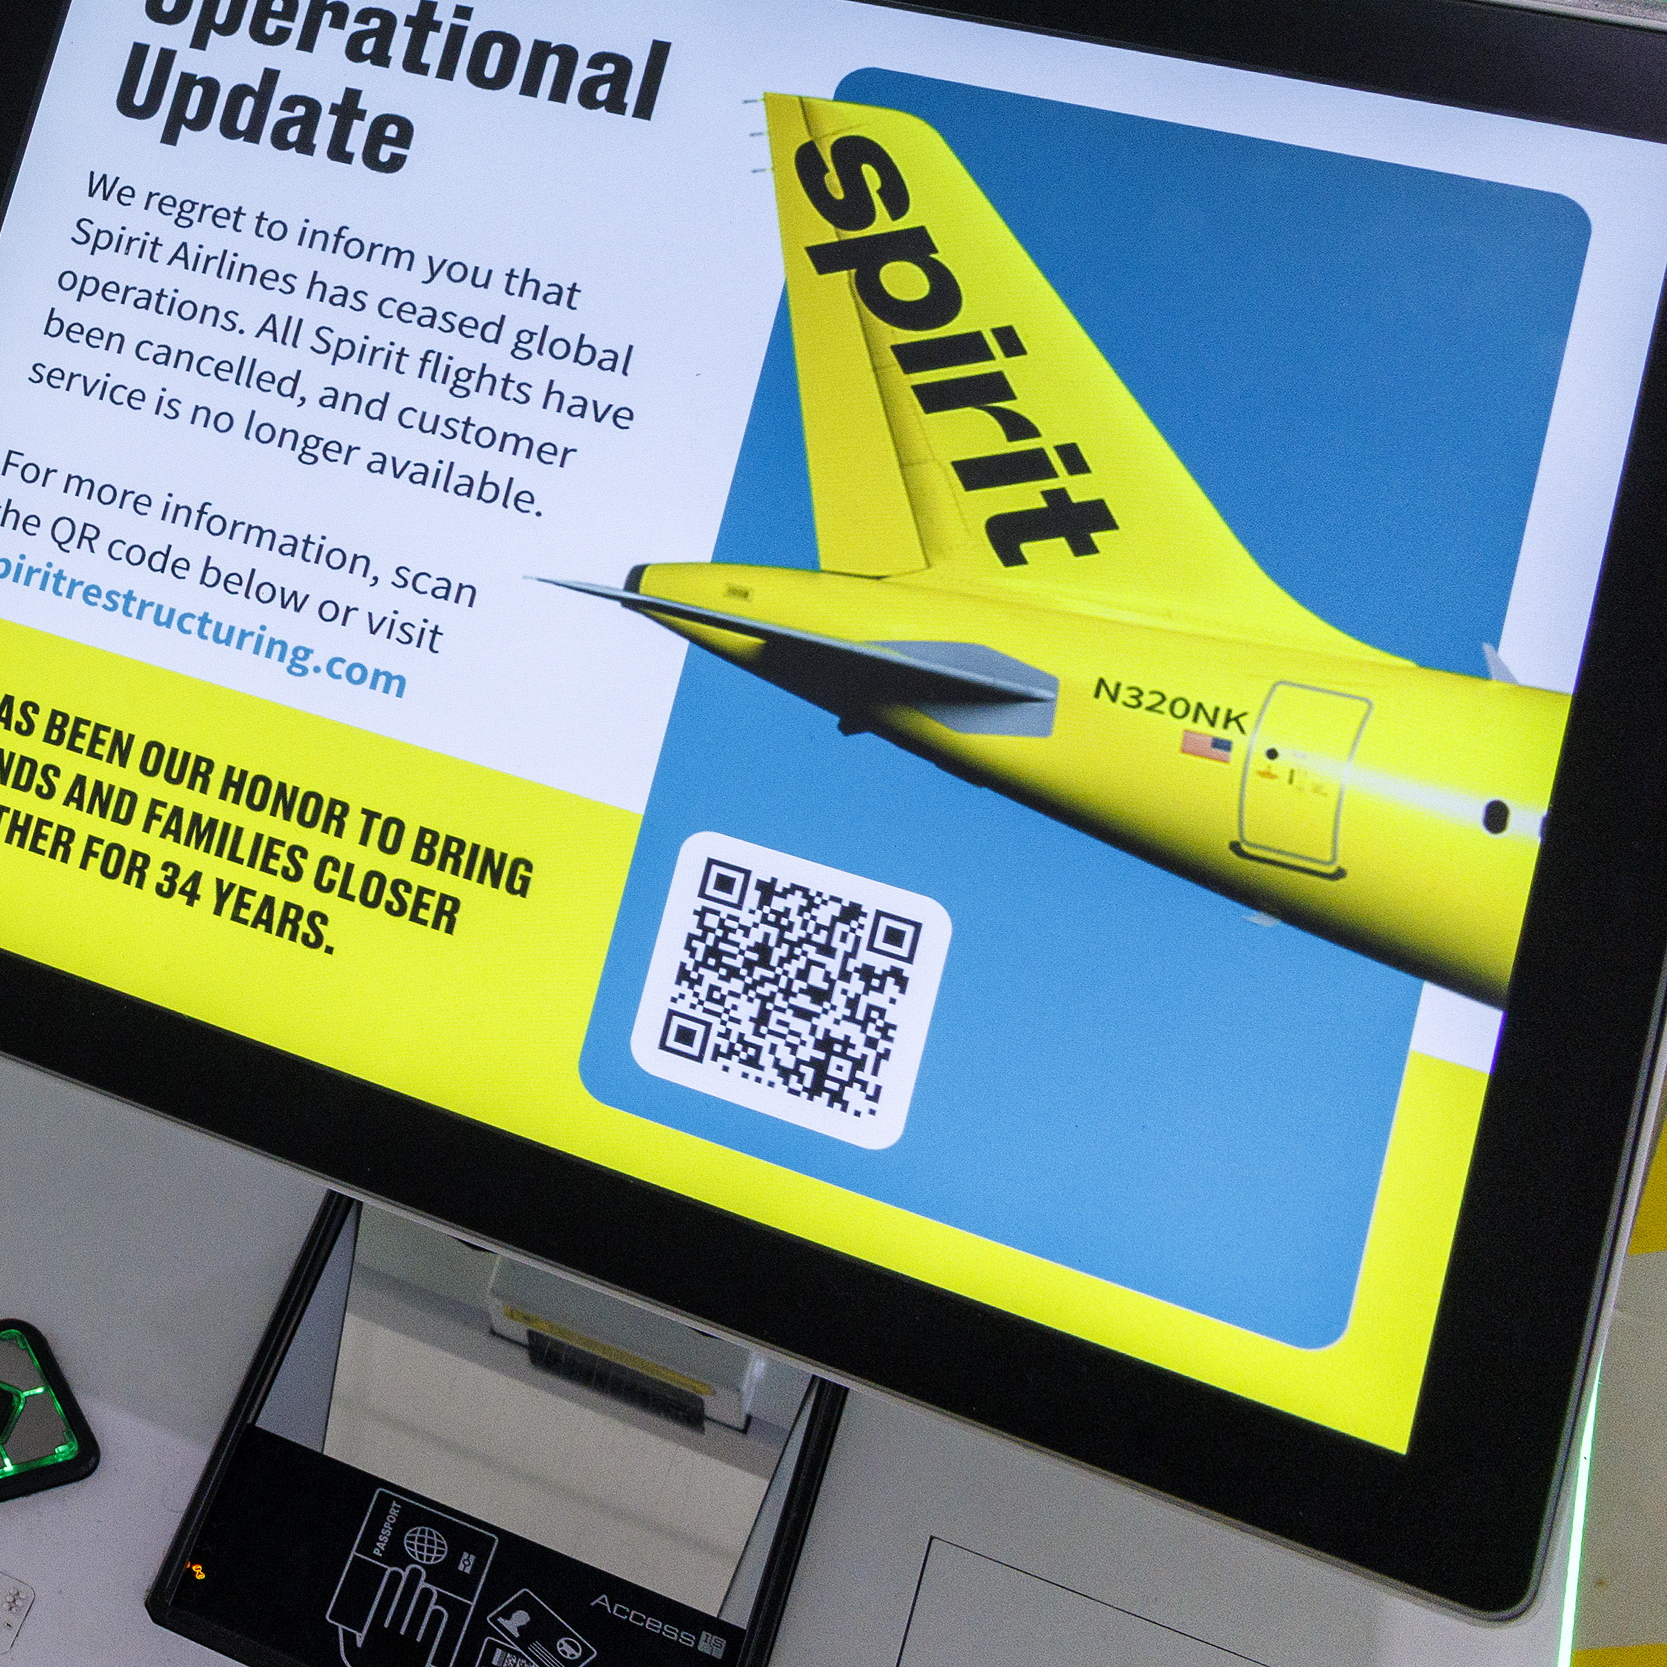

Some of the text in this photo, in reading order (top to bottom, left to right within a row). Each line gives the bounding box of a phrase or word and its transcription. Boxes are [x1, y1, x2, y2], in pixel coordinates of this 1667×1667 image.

[116, 42, 414, 174] Update
[71, 218, 633, 376] Spirit Airlines has ceased global
[88, 171, 581, 310] We regret to inform you that
[44, 307, 577, 468] been cancelled, and customer
[58, 270, 634, 430] operations. All Spirit flights have
[794, 133, 1120, 568] spirit
[28, 363, 542, 517] service is no longer available.
[1, 450, 476, 607] For more information, scan
[51, 516, 100, 553] QR
[108, 539, 190, 579] code
[200, 556, 309, 613] below
[318, 600, 358, 626] or
[368, 610, 443, 654] visit
[1093, 677, 1249, 735] N320NK
[43, 709, 135, 768] BEEN
[139, 740, 215, 794] OUR
[219, 765, 350, 838] HONOR
[359, 808, 406, 855] TO
[411, 826, 533, 898] BRING
[63, 774, 138, 826] AND
[142, 798, 308, 882] FAMILIES
[313, 855, 461, 935] CLOSER
[79, 835, 151, 890] FOR
[155, 861, 203, 907] 34
[213, 878, 334, 955] YEARS.
[373, 1501, 402, 1557] PASSPORT
